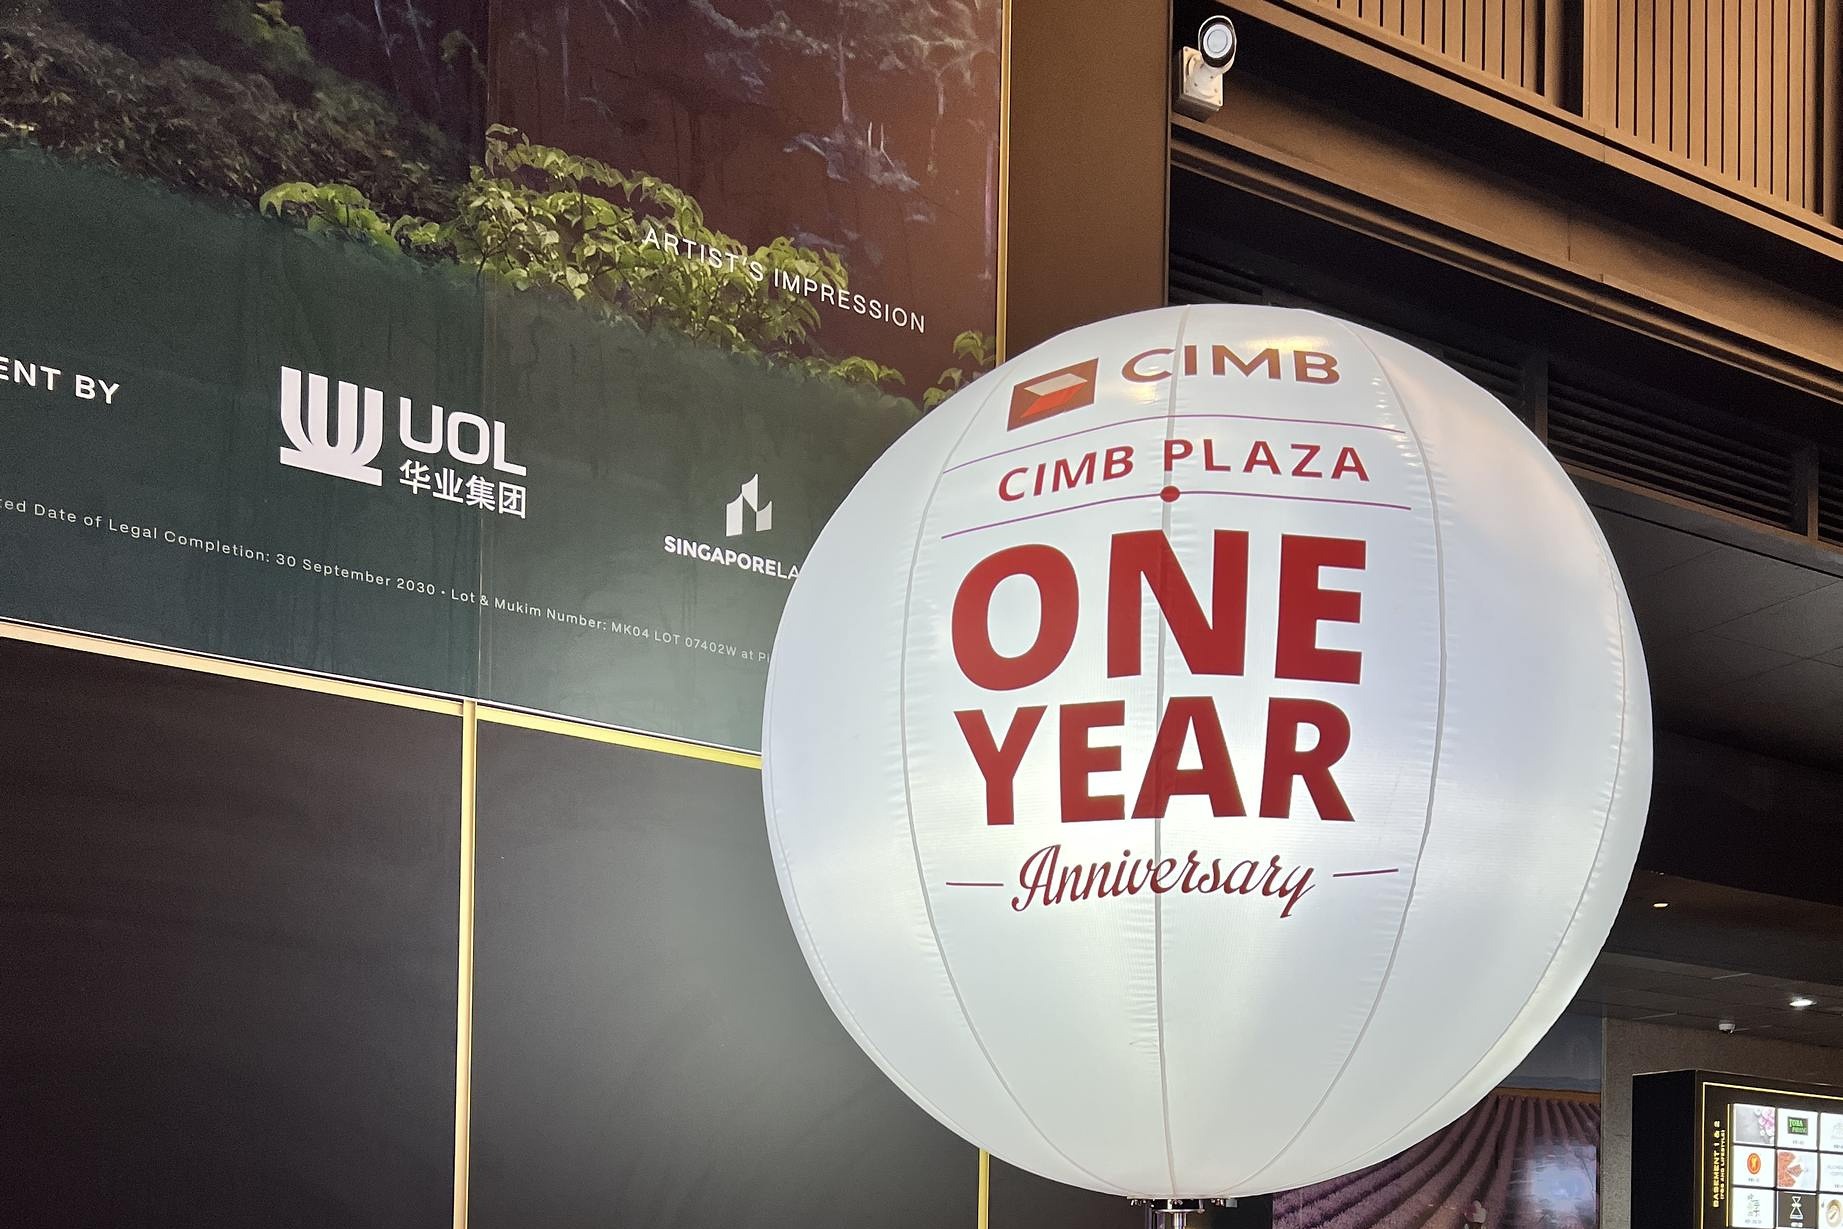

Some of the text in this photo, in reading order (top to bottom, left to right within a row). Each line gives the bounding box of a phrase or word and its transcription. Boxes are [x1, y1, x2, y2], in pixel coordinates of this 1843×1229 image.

[643, 226, 926, 333] ARTIST'S IMPRESSION
[74, 373, 120, 404] BY
[1121, 344, 1341, 386] CIMB
[399, 396, 527, 477] UOL
[998, 438, 1370, 503] CIMB PLAZA
[399, 459, 527, 519] 华业集团
[34, 503, 77, 523] Date
[83, 514, 103, 528] of
[109, 518, 158, 540] Legal
[164, 530, 270, 563] Completion:
[276, 553, 297, 568] 30
[302, 558, 391, 587] September
[397, 578, 435, 595] 2030
[451, 589, 476, 603] Lot
[480, 594, 489, 607] &
[494, 598, 542, 617] Mukim
[546, 608, 608, 631] Number:
[611, 622, 649, 640] MK04
[654, 631, 681, 646] LOT
[685, 637, 737, 657] 07402W
[741, 650, 754, 661] at
[951, 529, 1367, 691] ONE
[954, 696, 1356, 826] YEAR
[1011, 844, 1317, 919] Anniversary
